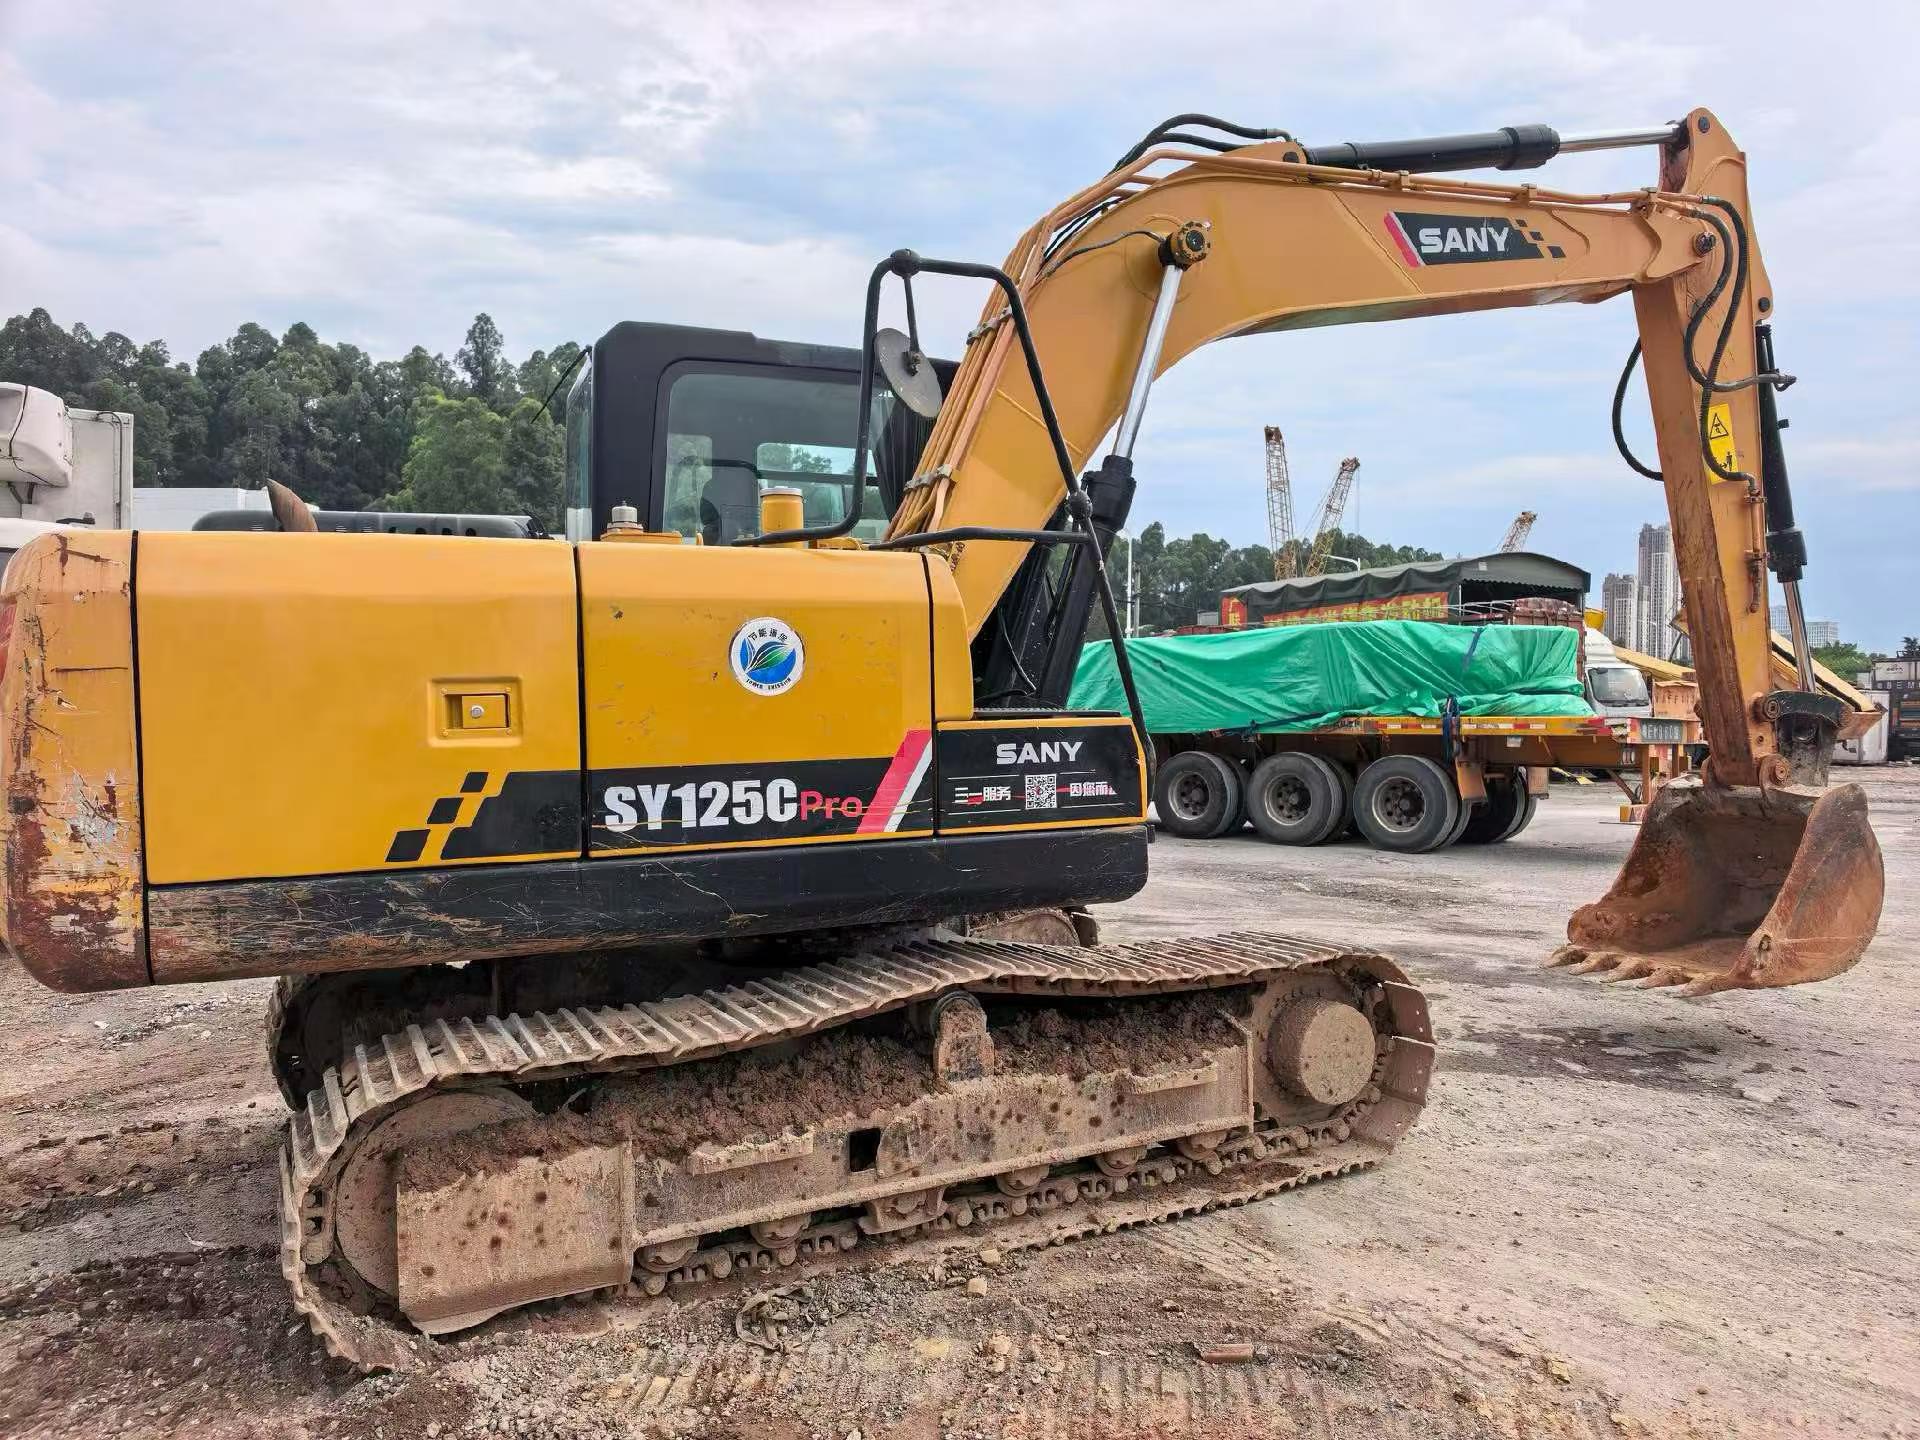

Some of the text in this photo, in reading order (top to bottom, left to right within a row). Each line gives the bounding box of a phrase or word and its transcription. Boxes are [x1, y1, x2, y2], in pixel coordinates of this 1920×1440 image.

[1418, 227, 1509, 253] SANY
[996, 741, 1083, 765] SANY
[1069, 781, 1118, 797] 因您而
